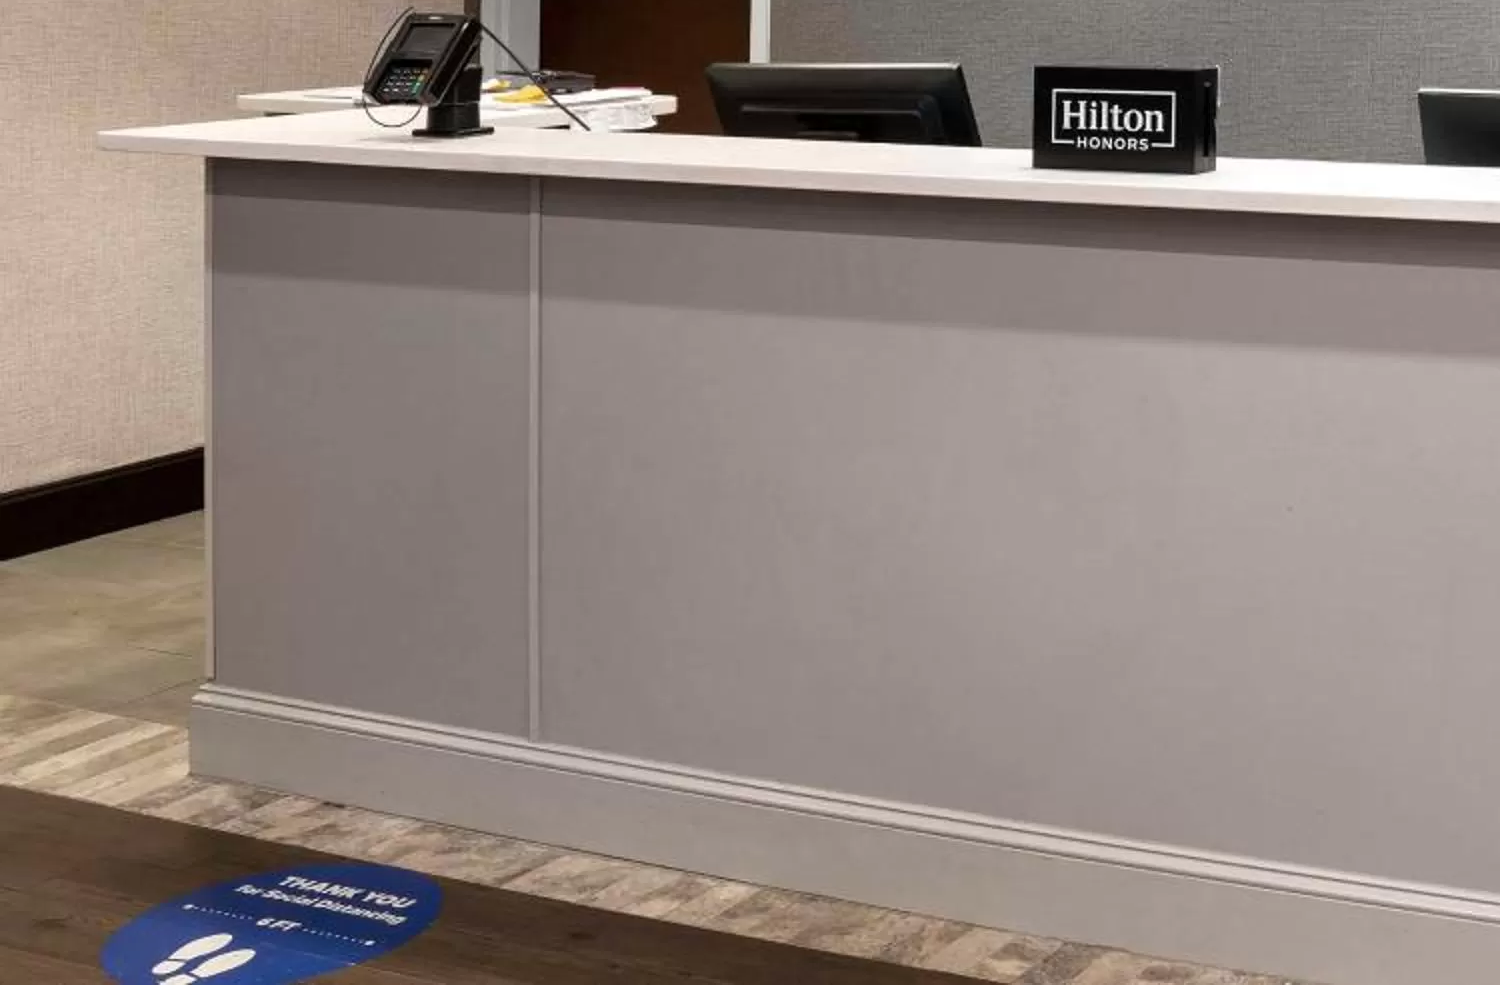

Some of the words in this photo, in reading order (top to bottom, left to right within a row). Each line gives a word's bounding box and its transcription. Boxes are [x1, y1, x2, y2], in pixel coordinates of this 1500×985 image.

[1062, 100, 1164, 132] Hilton
[1076, 136, 1149, 151] HONORS
[261, 889, 320, 906] Social
[312, 898, 408, 925] Distancing
[278, 875, 366, 899] THANK
[361, 891, 417, 908] YOU
